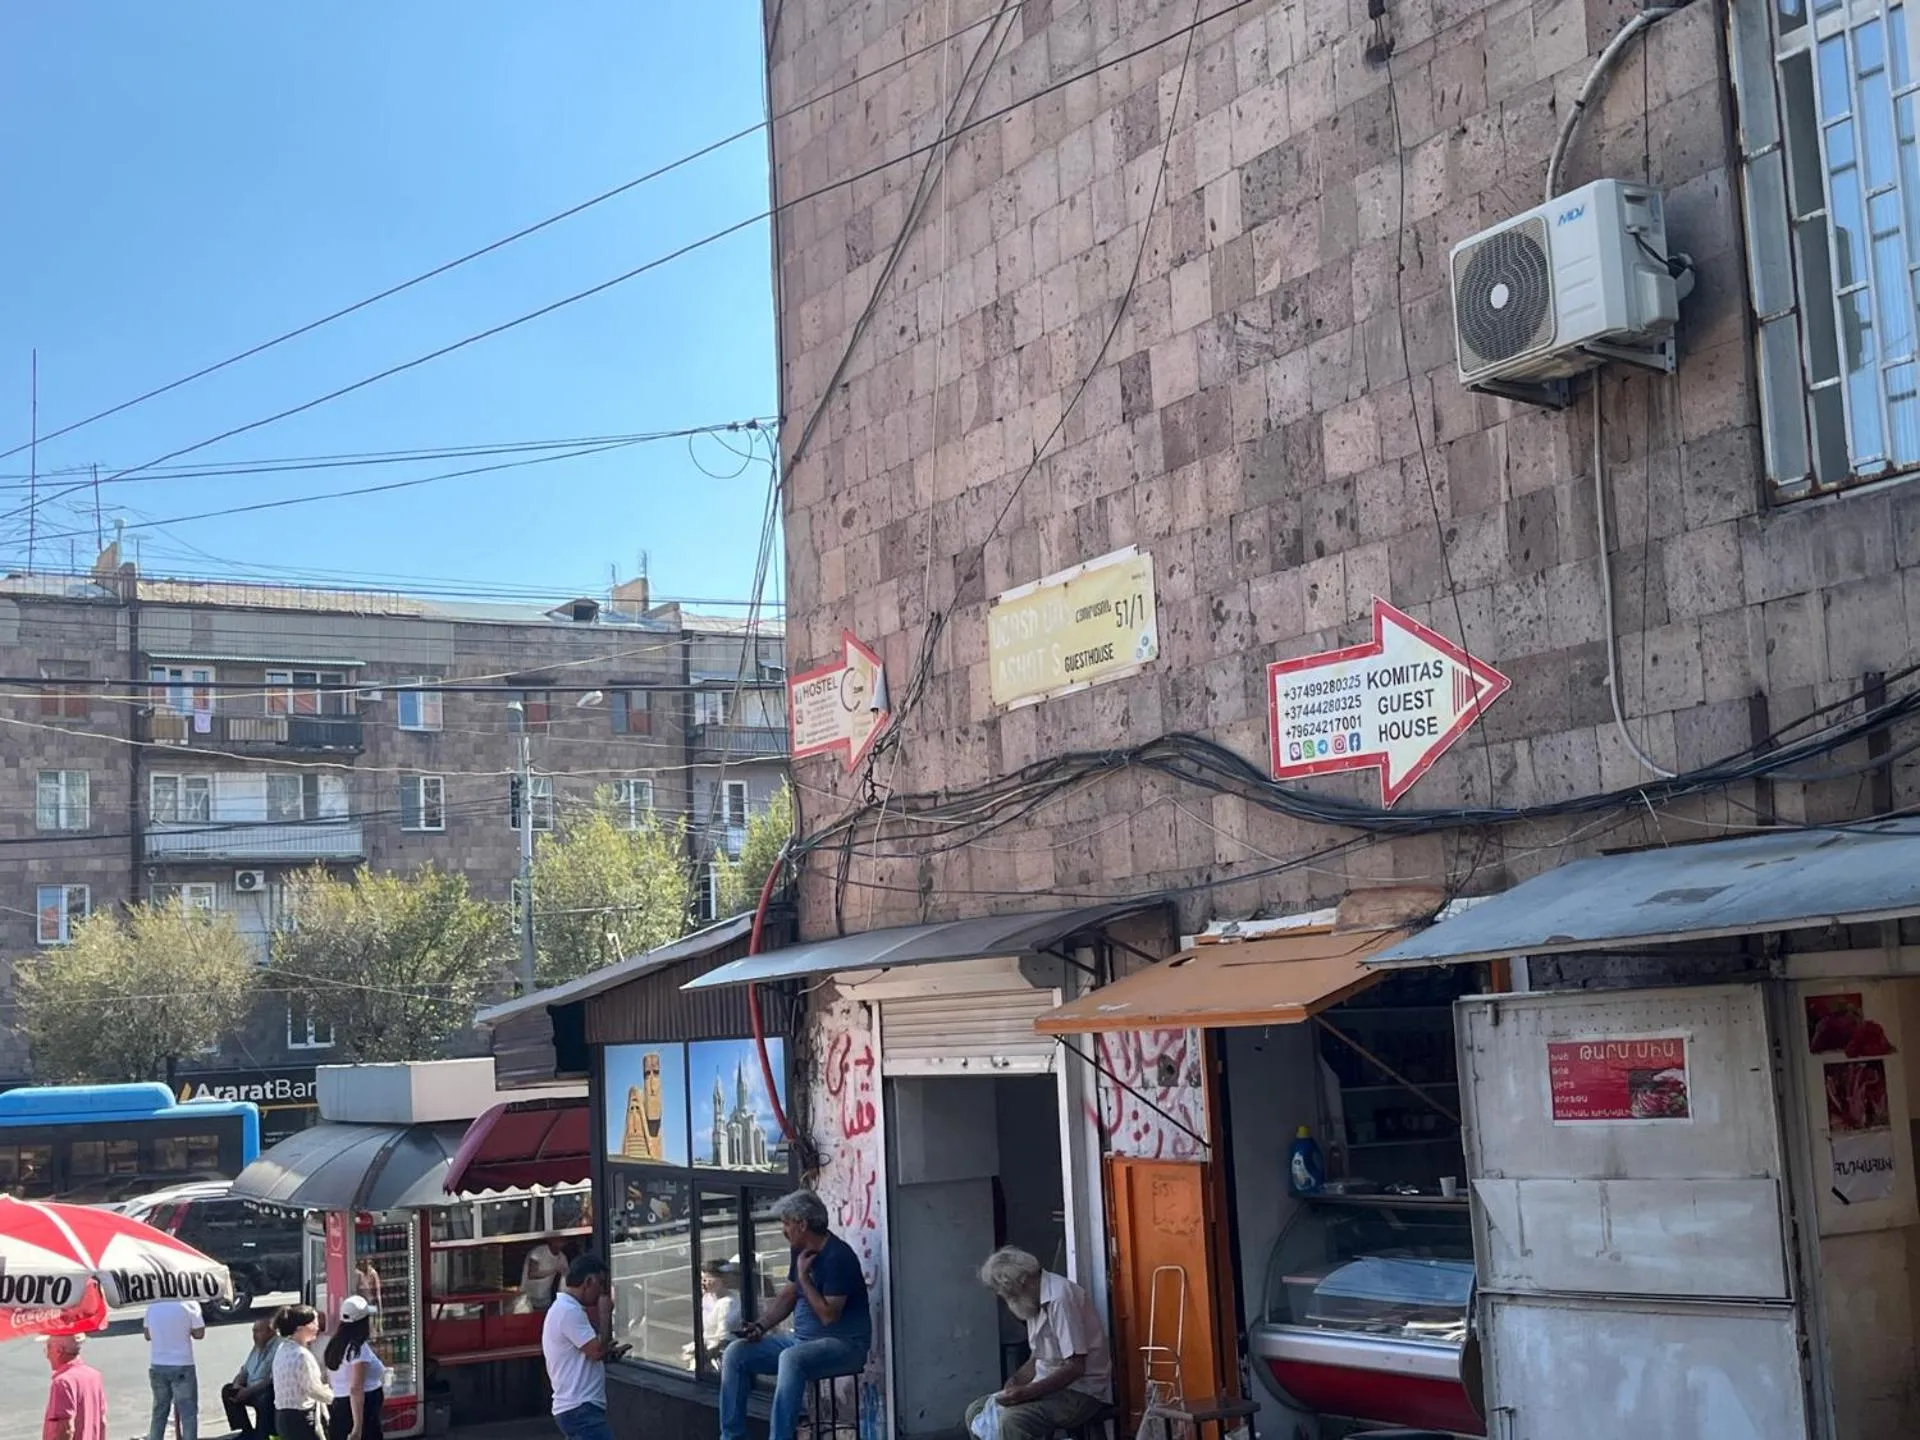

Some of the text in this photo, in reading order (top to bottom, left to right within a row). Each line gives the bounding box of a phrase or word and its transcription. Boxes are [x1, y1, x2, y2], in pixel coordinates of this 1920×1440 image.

[1064, 642, 1115, 672] GUESTHOUSE
[803, 678, 838, 697] HOSTEL
[1283, 674, 1362, 701] +37499280325
[1366, 659, 1444, 690] KOMITAS
[1284, 694, 1363, 720] +37444280325
[1377, 688, 1435, 716] GUEST
[1285, 714, 1363, 740] +79624217001
[1378, 716, 1439, 743] HOUSE
[1579, 1043, 1631, 1062] ԹԱՐՄ
[114, 1252, 219, 1304] Marlboro
